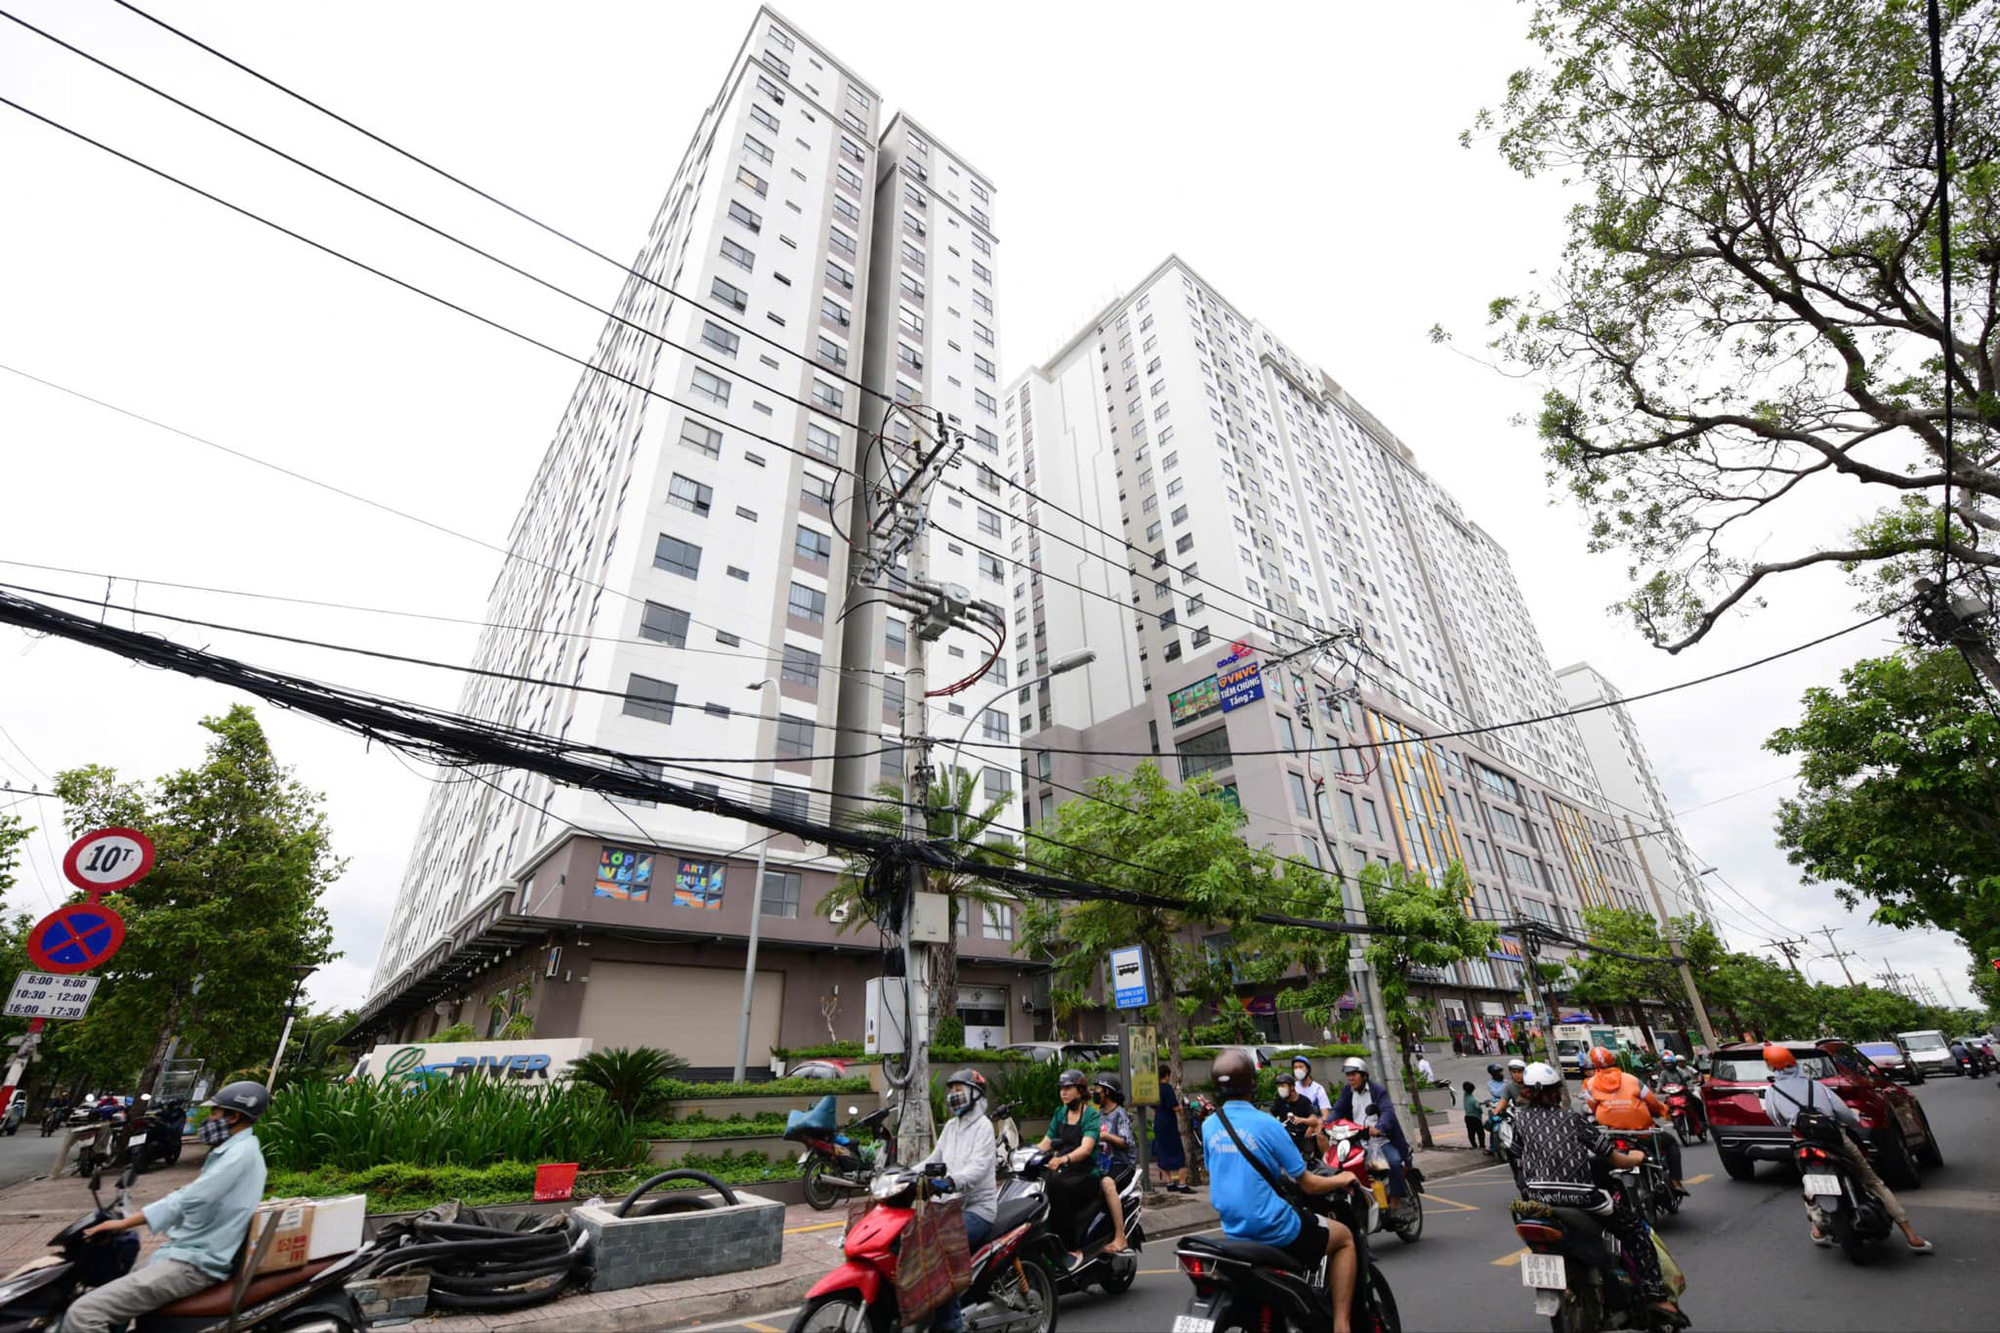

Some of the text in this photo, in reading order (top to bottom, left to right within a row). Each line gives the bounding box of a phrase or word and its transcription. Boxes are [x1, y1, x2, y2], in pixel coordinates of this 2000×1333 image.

[1227, 665, 1257, 683] VNVC
[1248, 690, 1255, 699] 2
[683, 863, 705, 874] ART
[676, 874, 707, 887] SMILE
[28, 975, 53, 986] 6:00
[62, 978, 87, 988] 8:00
[15, 989, 46, 1000] 10:30
[57, 992, 87, 1002] 12:00
[8, 1004, 39, 1014] 16:00
[50, 1006, 81, 1017] 17:30
[451, 1054, 551, 1080] RIVER
